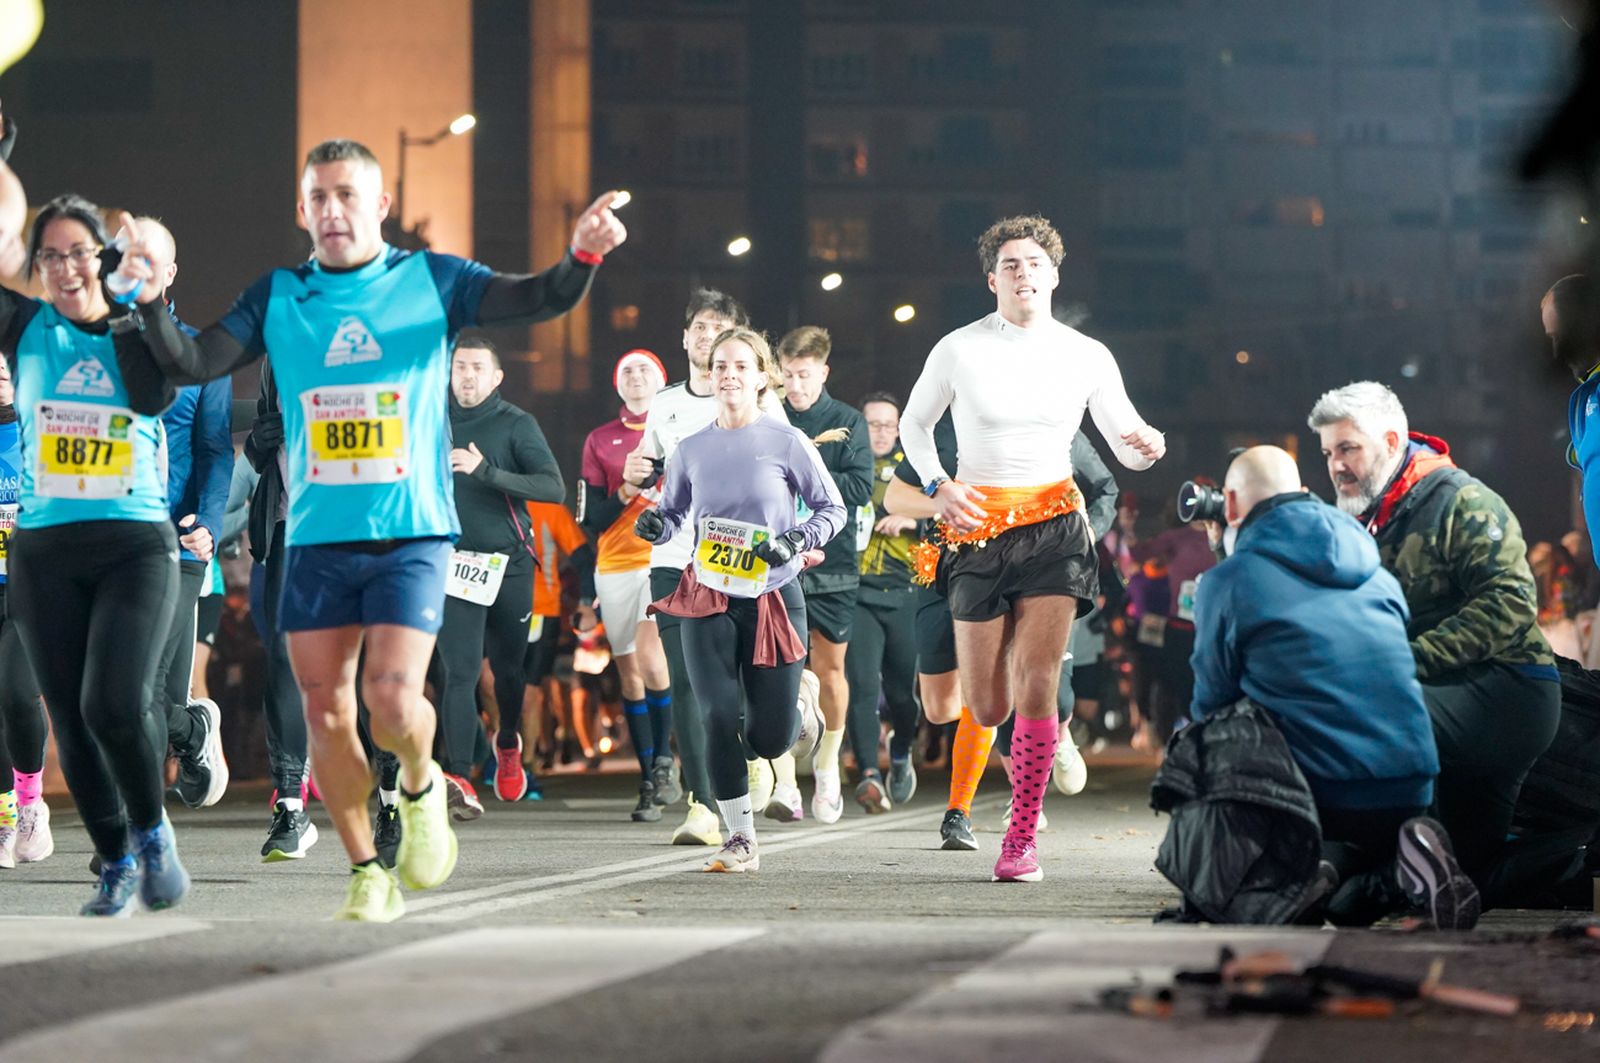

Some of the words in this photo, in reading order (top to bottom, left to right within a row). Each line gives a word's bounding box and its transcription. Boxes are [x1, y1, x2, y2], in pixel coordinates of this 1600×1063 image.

[326, 421, 384, 450] 8871
[56, 436, 113, 467] 8877
[708, 532, 721, 542] SAN
[722, 535, 746, 546] ANTÓN
[717, 526, 738, 535] NOCHE
[708, 543, 755, 571] 2370
[454, 563, 489, 585] 1024
